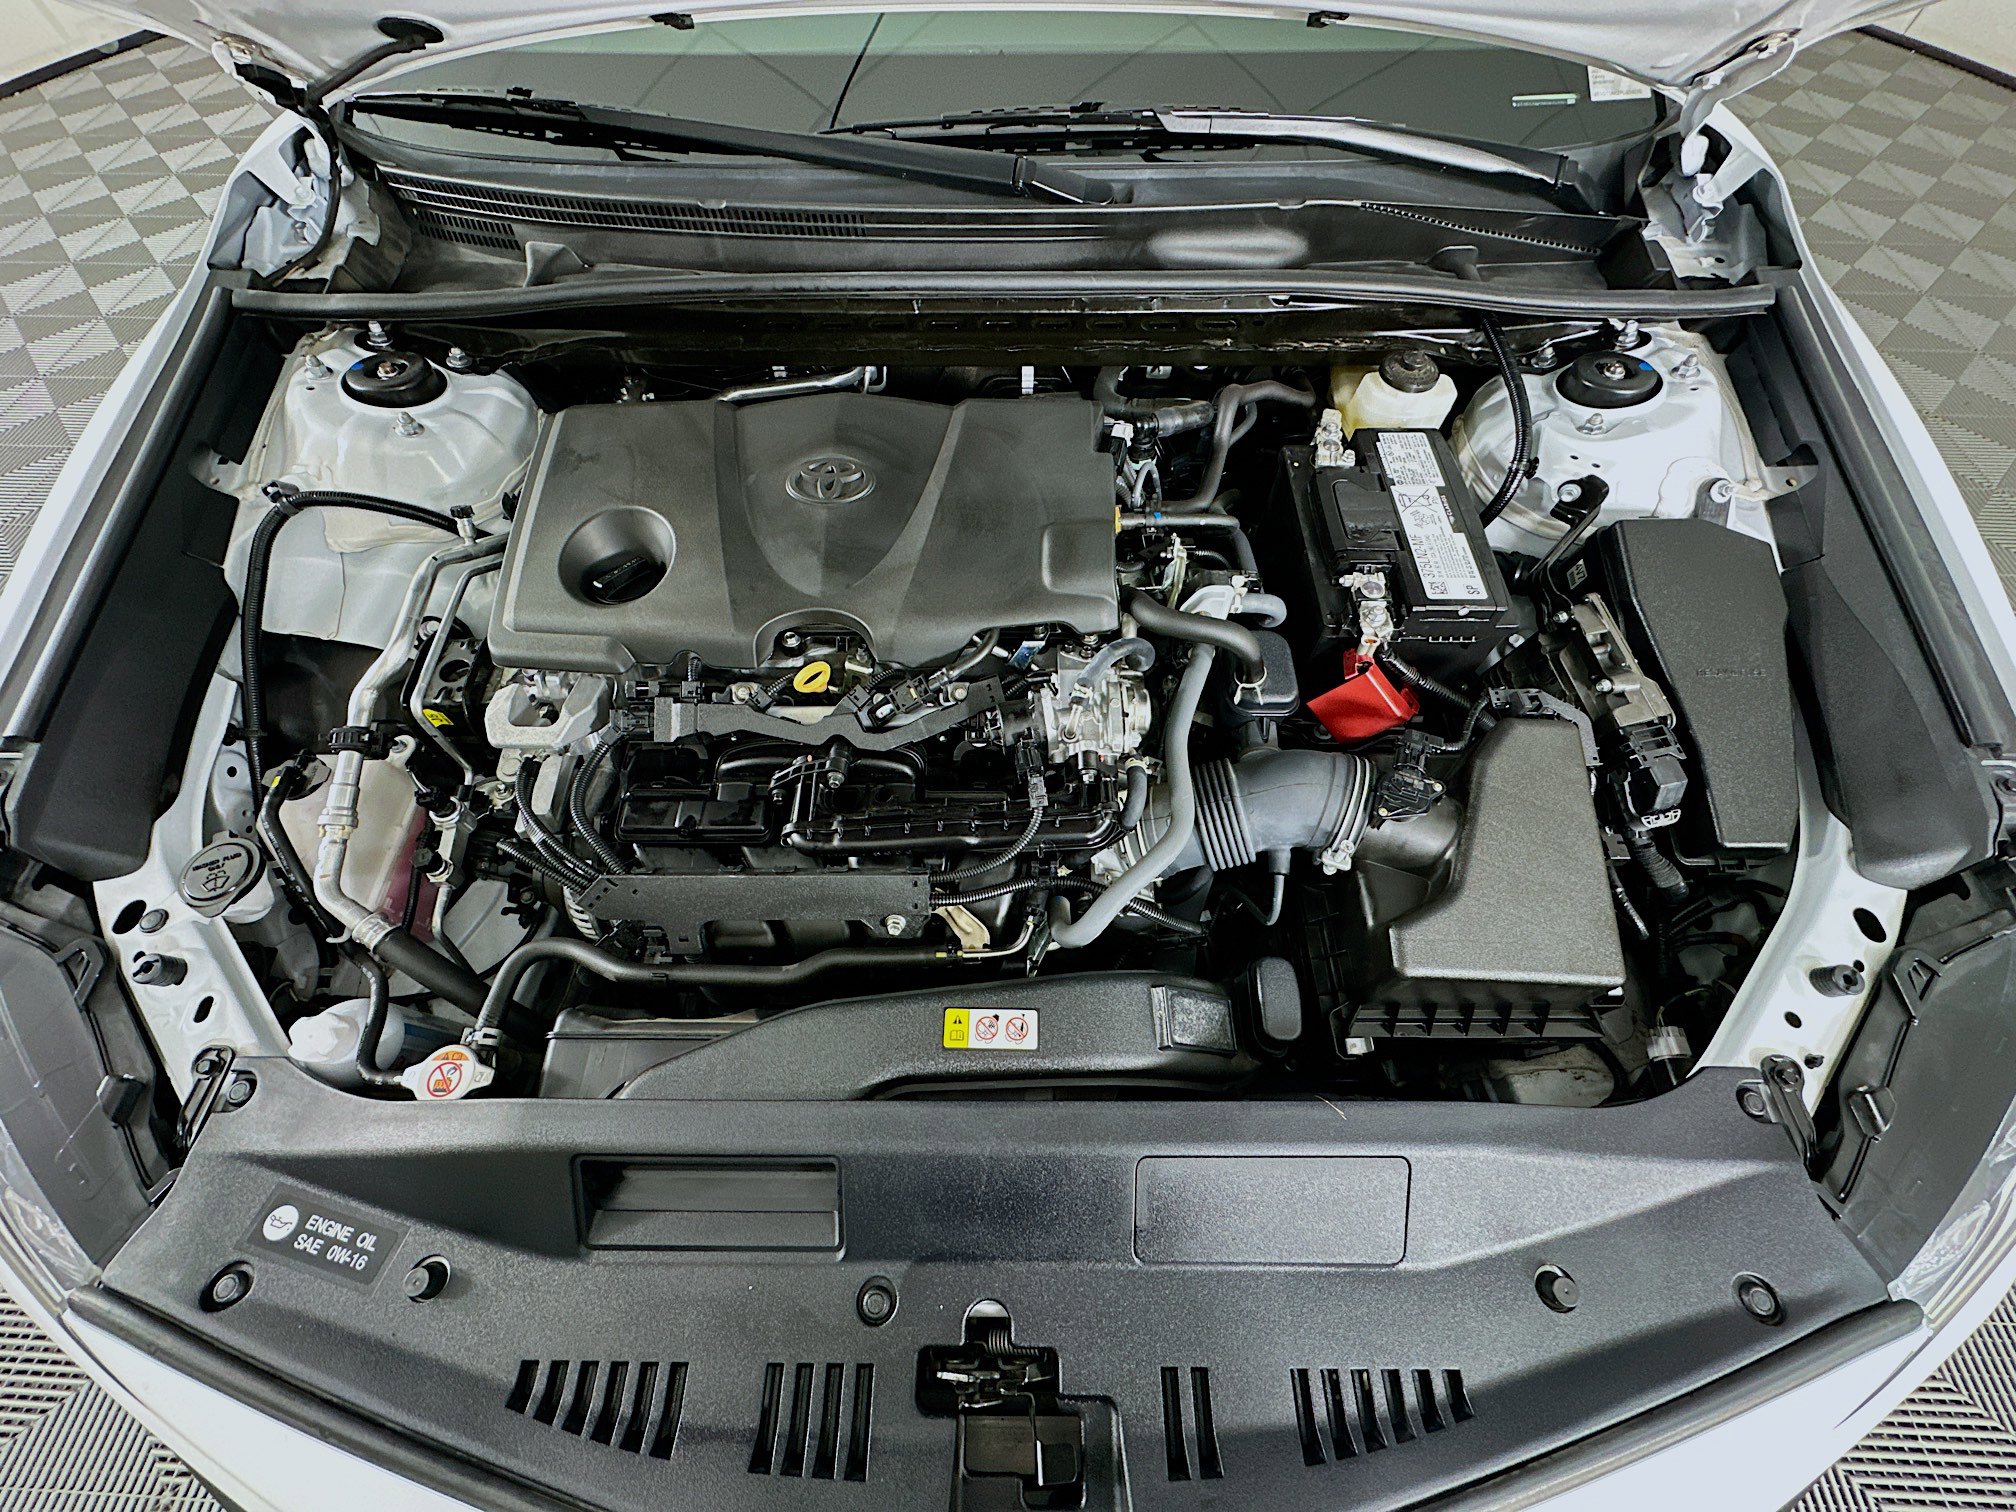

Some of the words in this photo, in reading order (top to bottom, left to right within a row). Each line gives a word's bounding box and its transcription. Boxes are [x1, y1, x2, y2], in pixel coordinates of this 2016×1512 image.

[1465, 585, 1481, 595] SP
[293, 1233, 325, 1255] SAE
[326, 1244, 369, 1271] 0W-16
[304, 1214, 355, 1243] ENGINE
[356, 1232, 378, 1252] OIL
